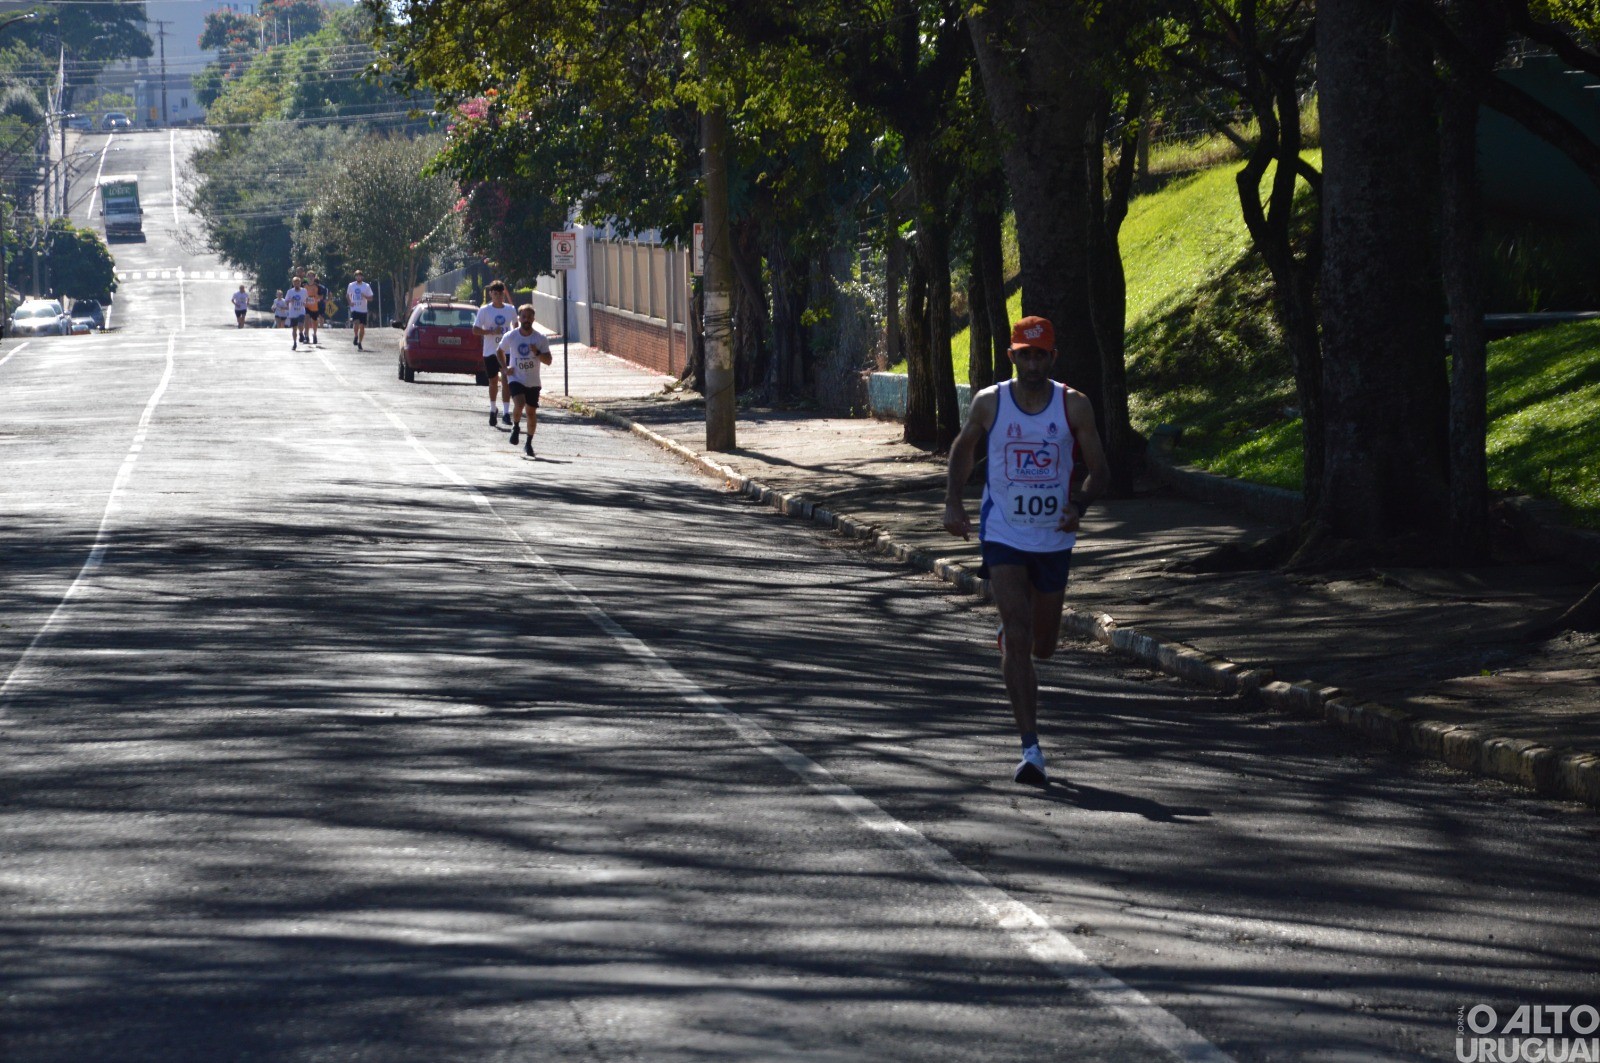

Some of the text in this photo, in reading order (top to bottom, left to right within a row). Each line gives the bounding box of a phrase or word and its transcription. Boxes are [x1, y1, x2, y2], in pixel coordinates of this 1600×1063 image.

[518, 361, 535, 370] 068
[1013, 449, 1052, 469] TAG
[1015, 468, 1050, 476] TARCISO
[1013, 495, 1058, 516] 109
